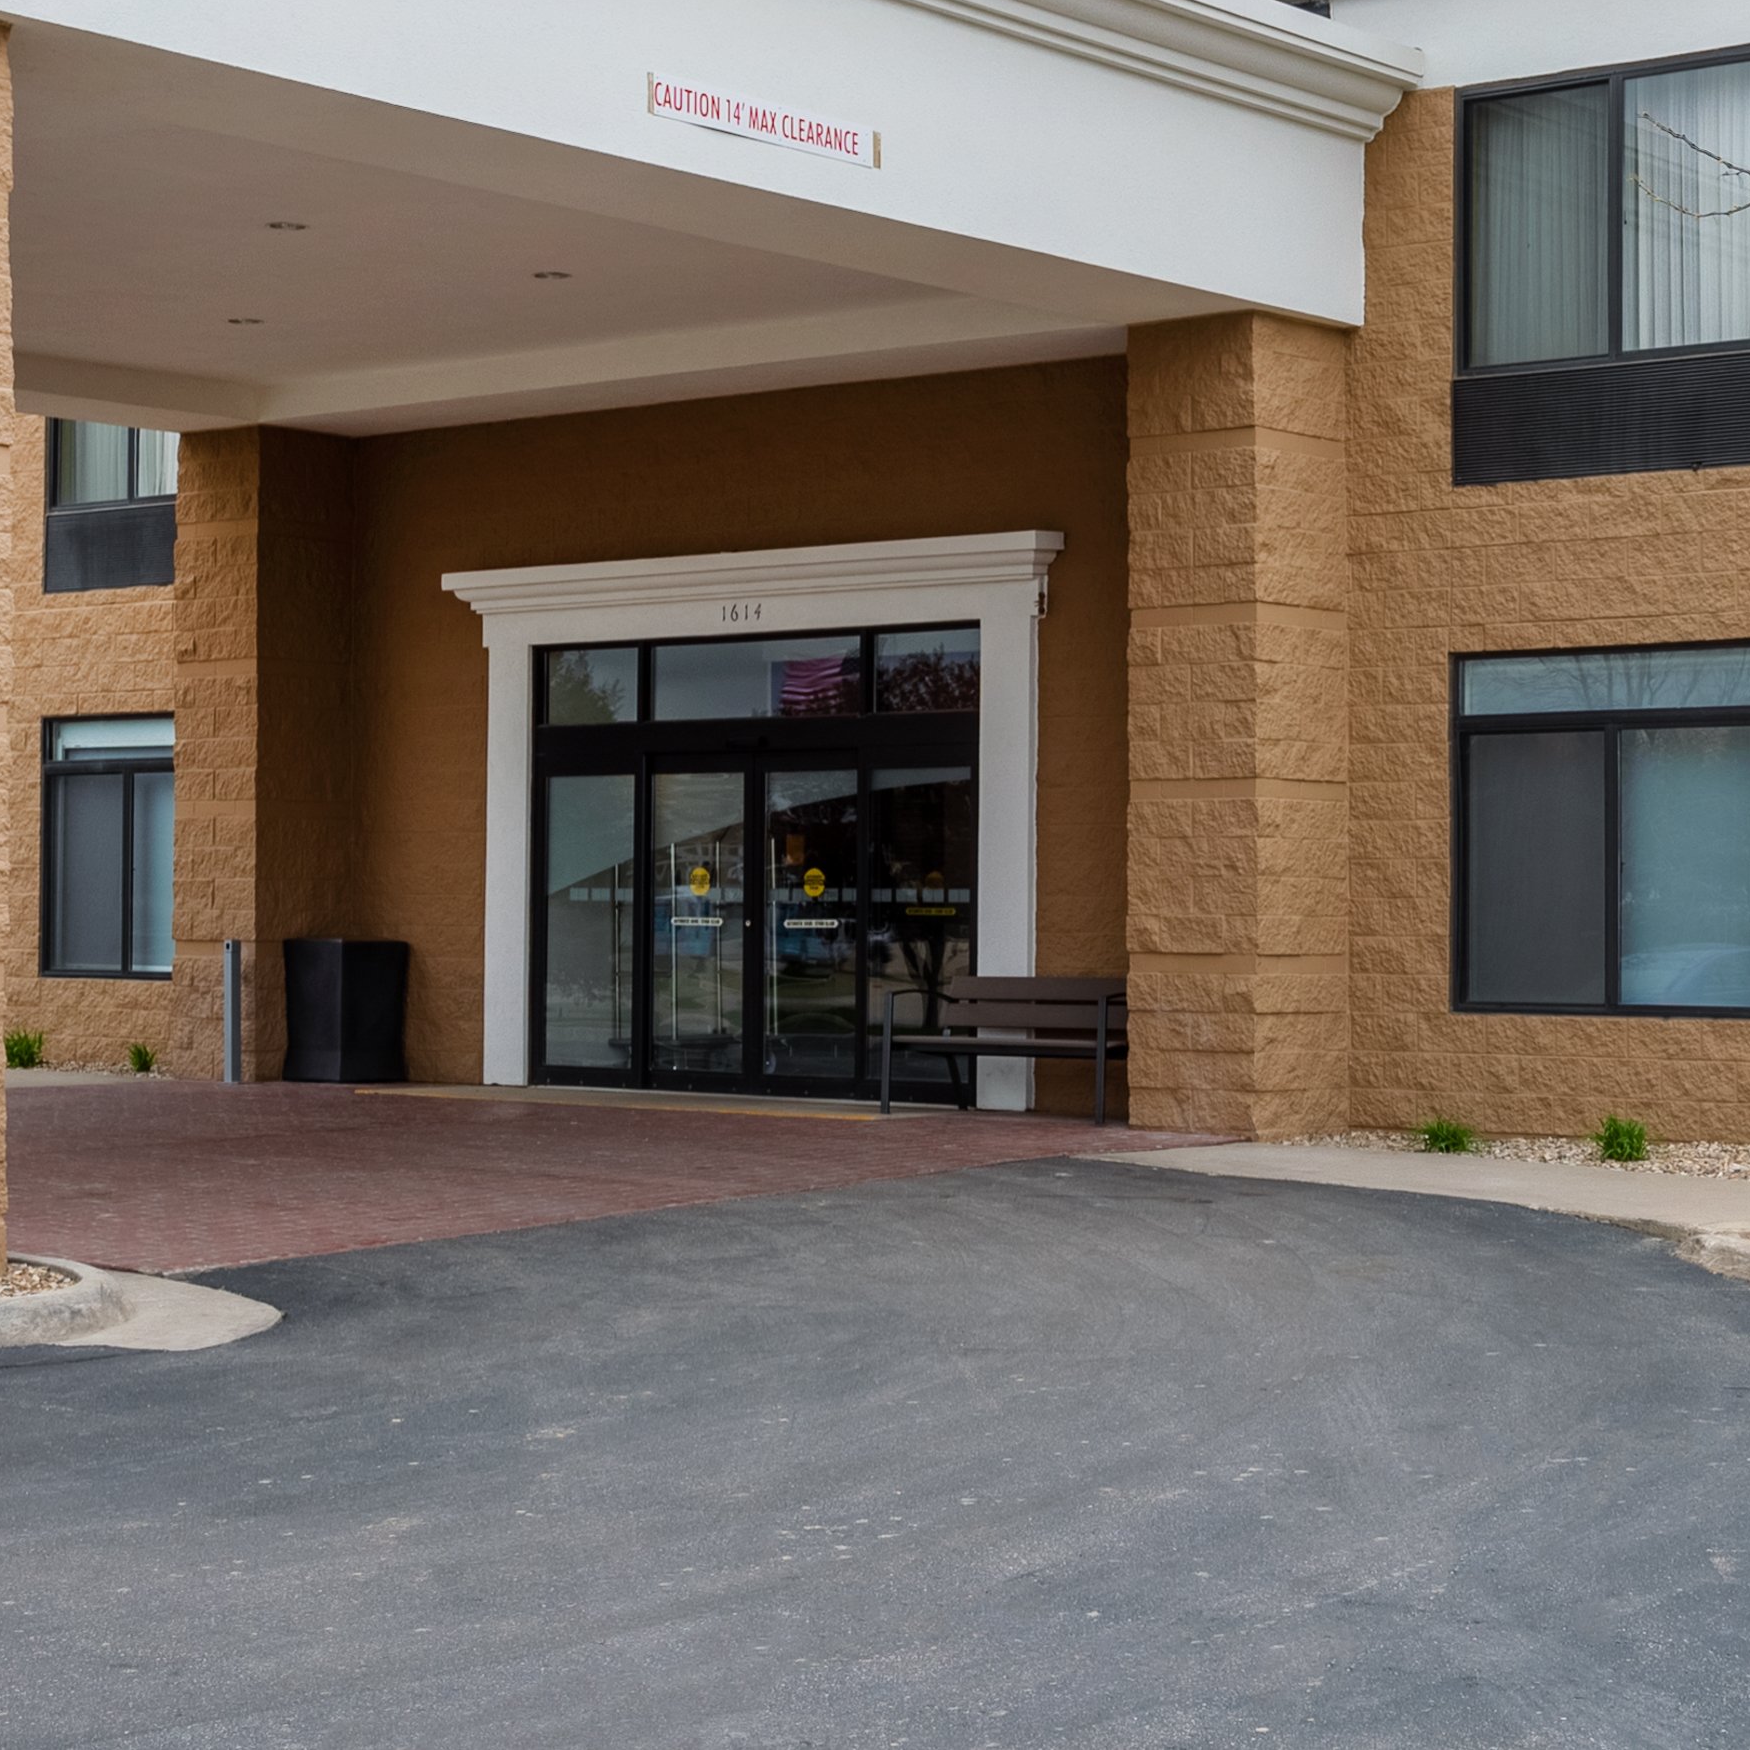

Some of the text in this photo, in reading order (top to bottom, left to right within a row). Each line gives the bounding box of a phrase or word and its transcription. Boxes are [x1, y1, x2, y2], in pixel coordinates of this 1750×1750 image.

[654, 82, 858, 156] CAUTION 14' MAX CLEARANCE
[722, 603, 762, 622] 1614
